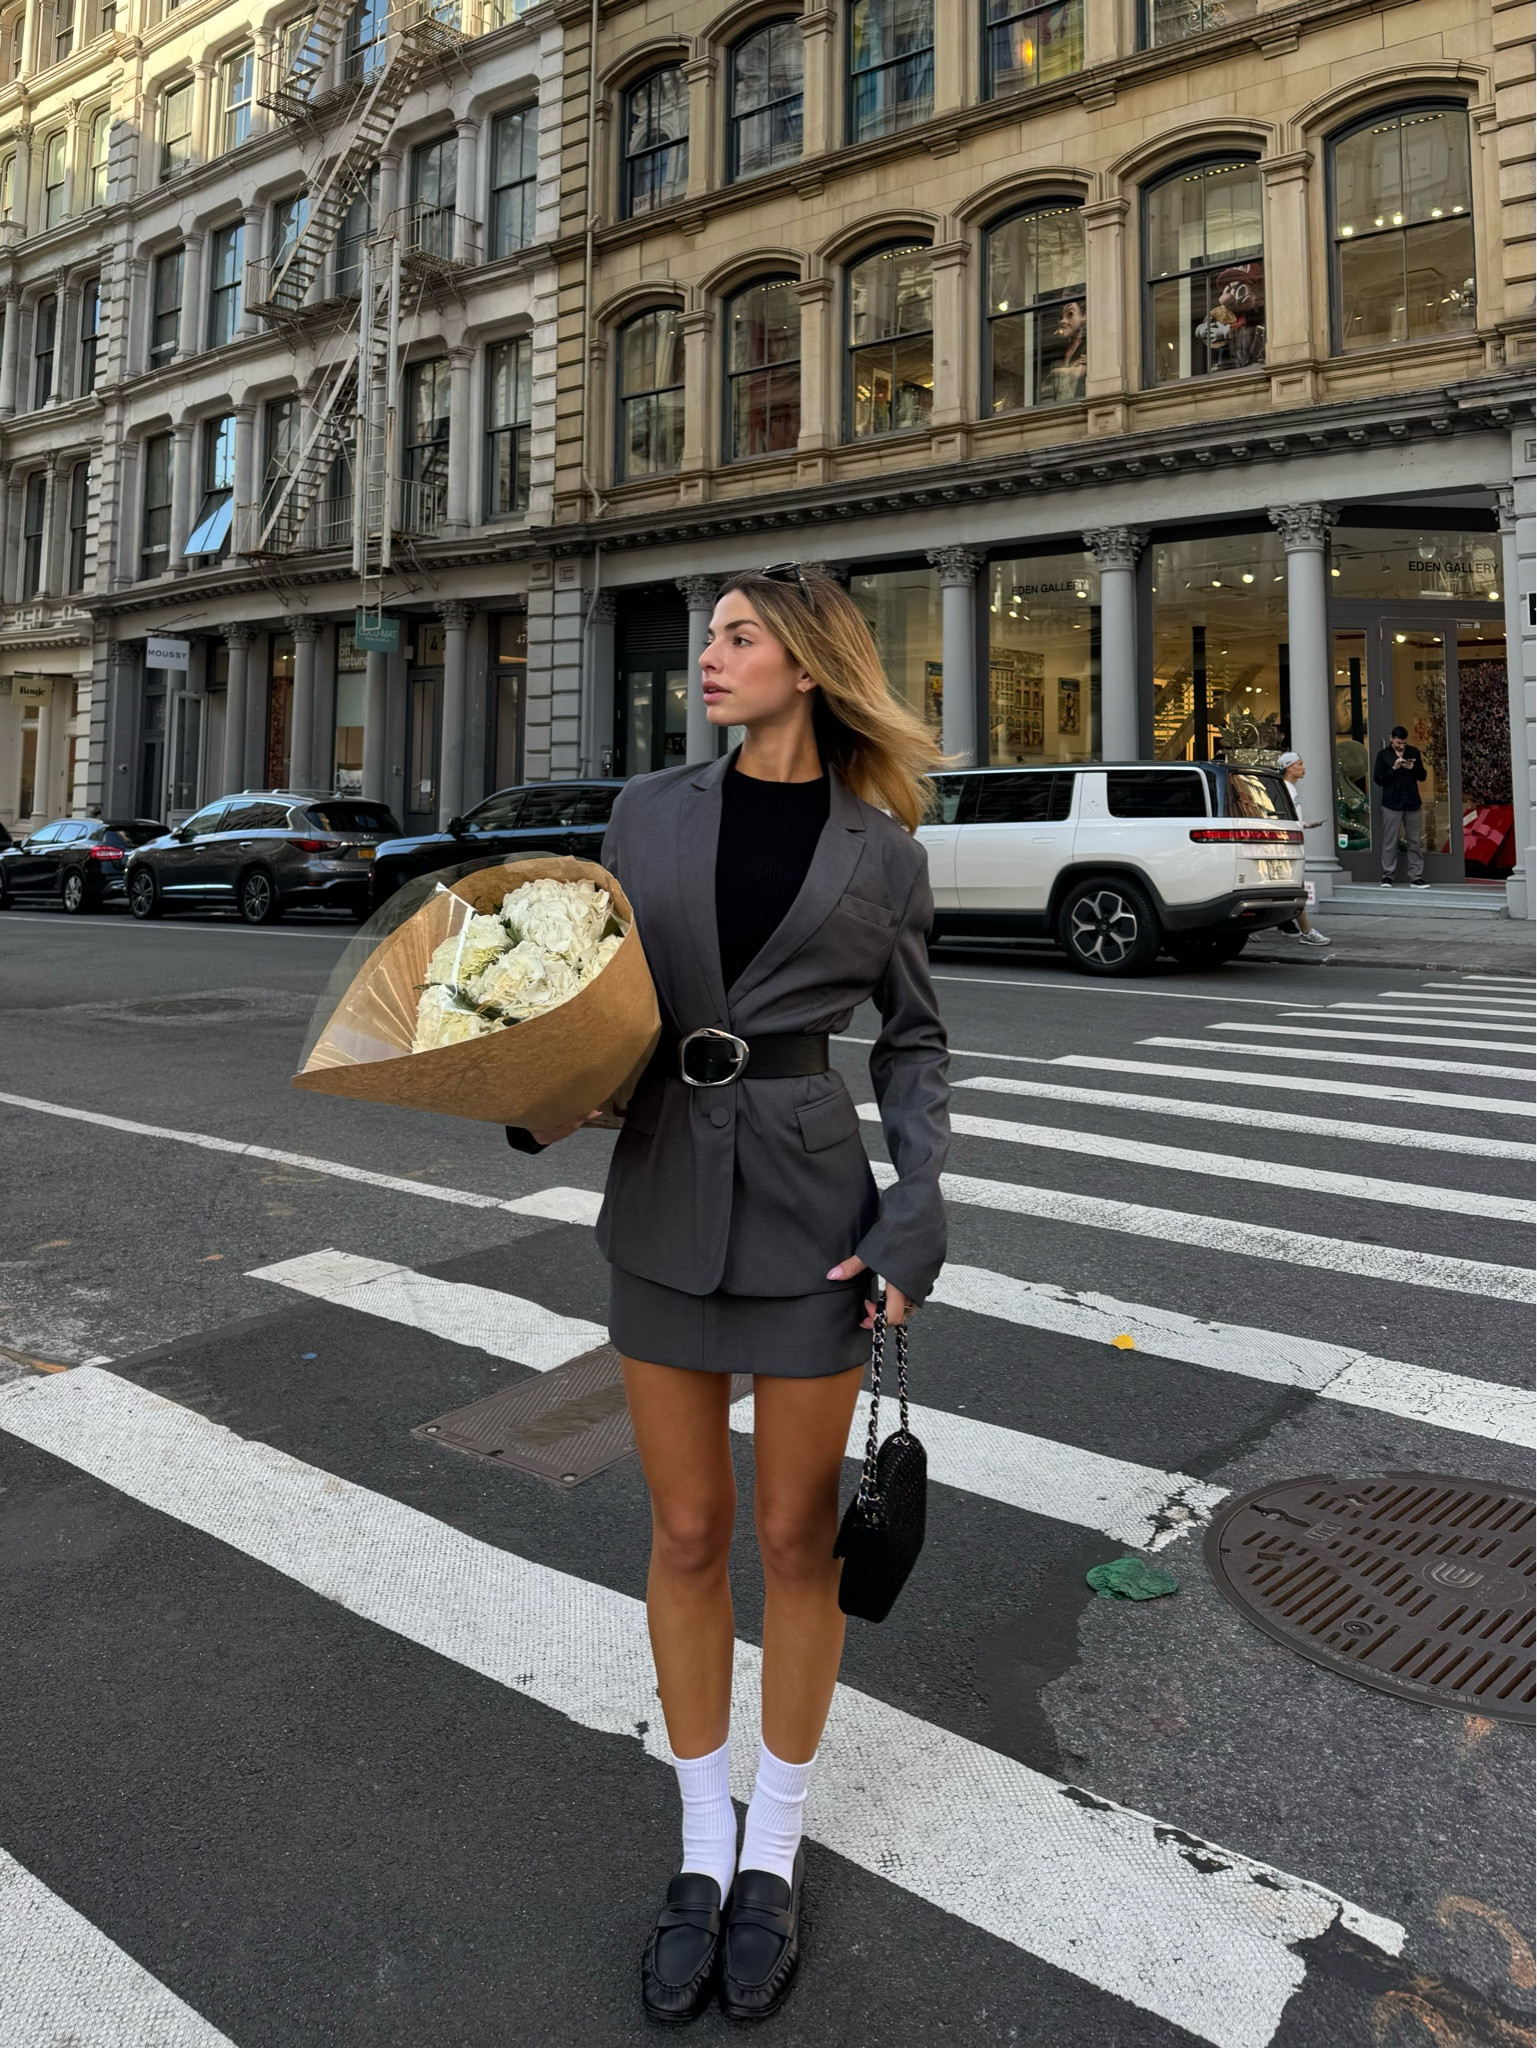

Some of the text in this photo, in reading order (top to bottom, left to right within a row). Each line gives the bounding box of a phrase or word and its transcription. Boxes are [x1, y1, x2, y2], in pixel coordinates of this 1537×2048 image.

[1408, 561, 1499, 574] EDEN GALLERY
[1012, 581, 1086, 596] EDEN GALLERY
[148, 649, 187, 659] MOUSSY
[19, 686, 46, 697] Rouje
